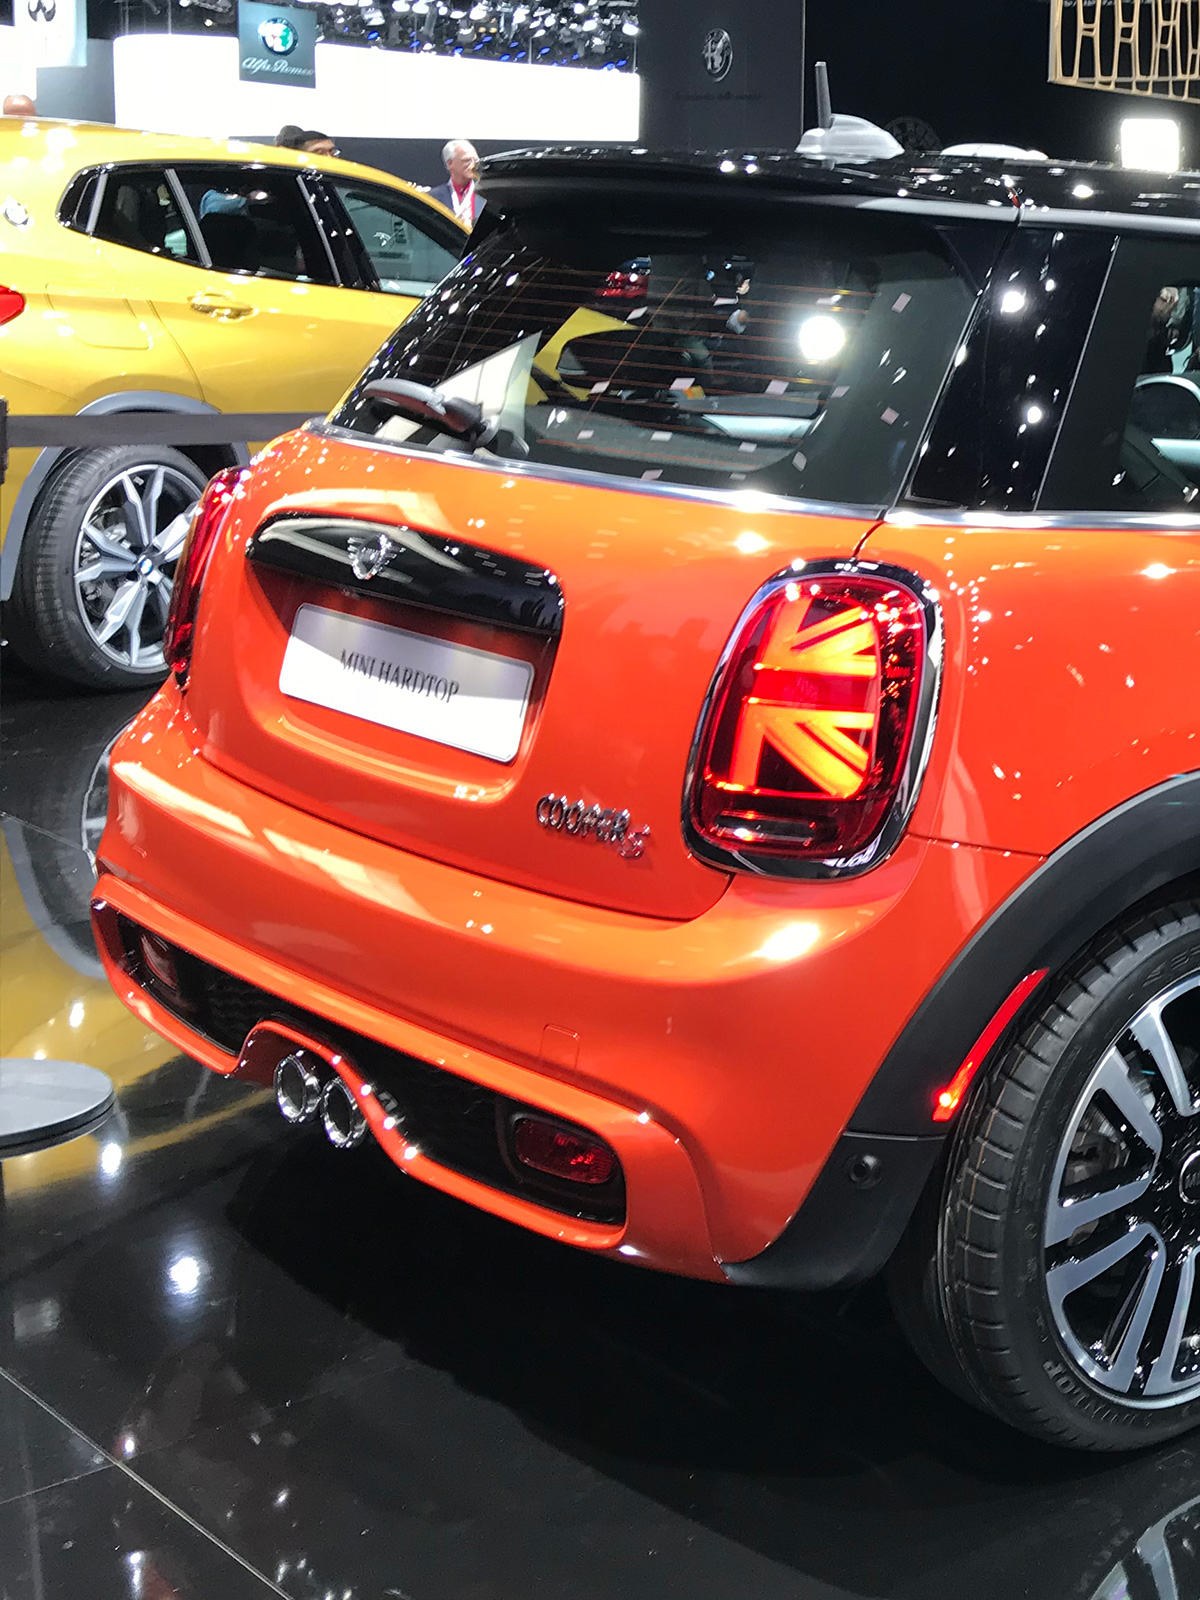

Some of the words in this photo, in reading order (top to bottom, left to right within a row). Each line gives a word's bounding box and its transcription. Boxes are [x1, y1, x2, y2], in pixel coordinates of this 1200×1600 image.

[241, 57, 271, 75] Alfa
[272, 59, 314, 76] Romeo
[340, 648, 377, 678] MINI
[378, 659, 460, 703] HARDTOP
[535, 791, 630, 844] COOPER
[617, 823, 651, 861] S
